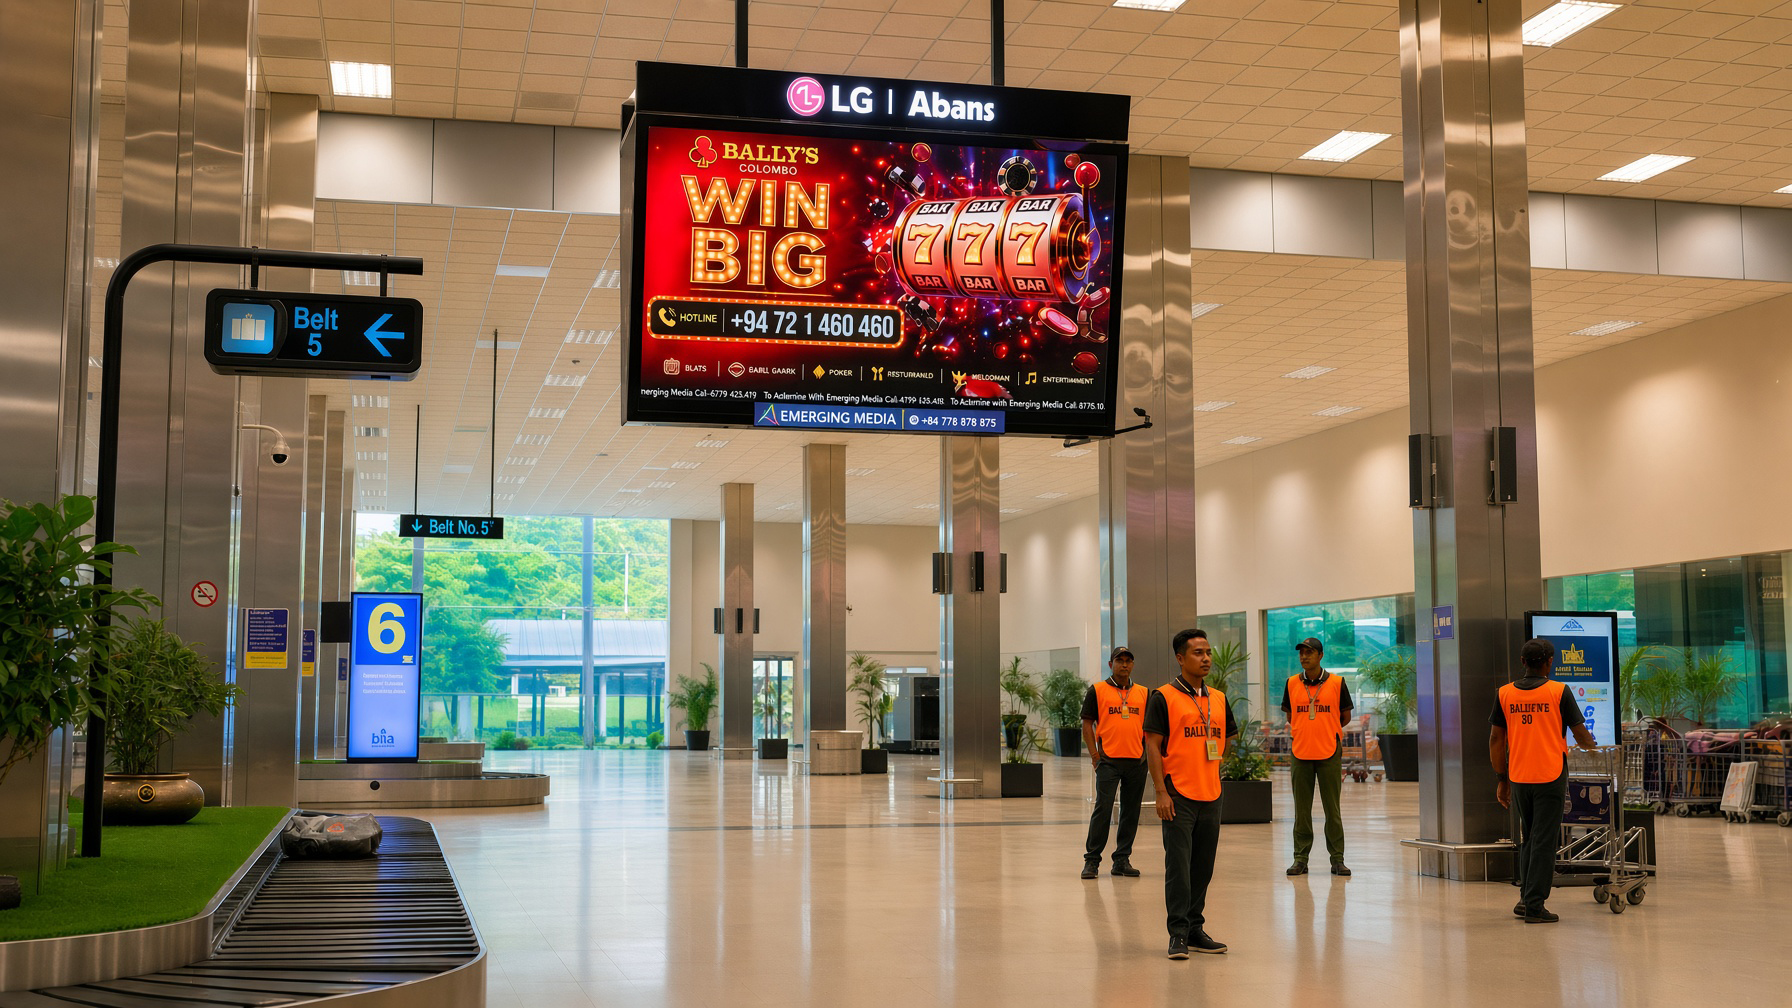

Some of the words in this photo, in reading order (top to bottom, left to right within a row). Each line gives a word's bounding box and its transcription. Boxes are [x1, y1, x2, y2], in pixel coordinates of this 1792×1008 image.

[832, 85, 873, 114] LG
[908, 90, 995, 122] Abans
[722, 142, 819, 164] BALLY'S
[739, 163, 798, 175] COLOMBO
[680, 174, 830, 229] WIN
[968, 201, 1001, 213] BAR
[1018, 199, 1052, 211] BAR
[908, 222, 944, 265] 7
[957, 221, 994, 265] 7
[1008, 221, 1047, 266] 7
[690, 227, 827, 289] BIG
[914, 276, 944, 288] BAR
[963, 277, 994, 290] BAR
[1016, 278, 1047, 292] BAR
[294, 306, 339, 331] Belt
[679, 313, 718, 323] HOTLINE
[731, 309, 769, 334] +94
[774, 311, 798, 335] 72
[804, 313, 813, 336] 1
[818, 313, 855, 337] 460
[858, 315, 895, 339] 460
[307, 332, 322, 357] 5
[829, 369, 853, 377] POKER
[670, 388, 693, 397] Media
[764, 391, 772, 399] To
[826, 394, 860, 405] Emerging
[861, 394, 884, 403] Media
[950, 397, 959, 406] To
[1009, 400, 1041, 411] Emerging
[1042, 401, 1063, 410] Media
[780, 410, 850, 424] EMERGING
[854, 412, 897, 426] MEDIA
[921, 416, 939, 426] +84
[941, 416, 958, 426] 778
[960, 417, 977, 427] 878
[979, 418, 997, 428] 875
[429, 518, 455, 534] Belt
[457, 519, 479, 535] No.
[367, 601, 406, 655] 6
[1521, 713, 1533, 725] 30
